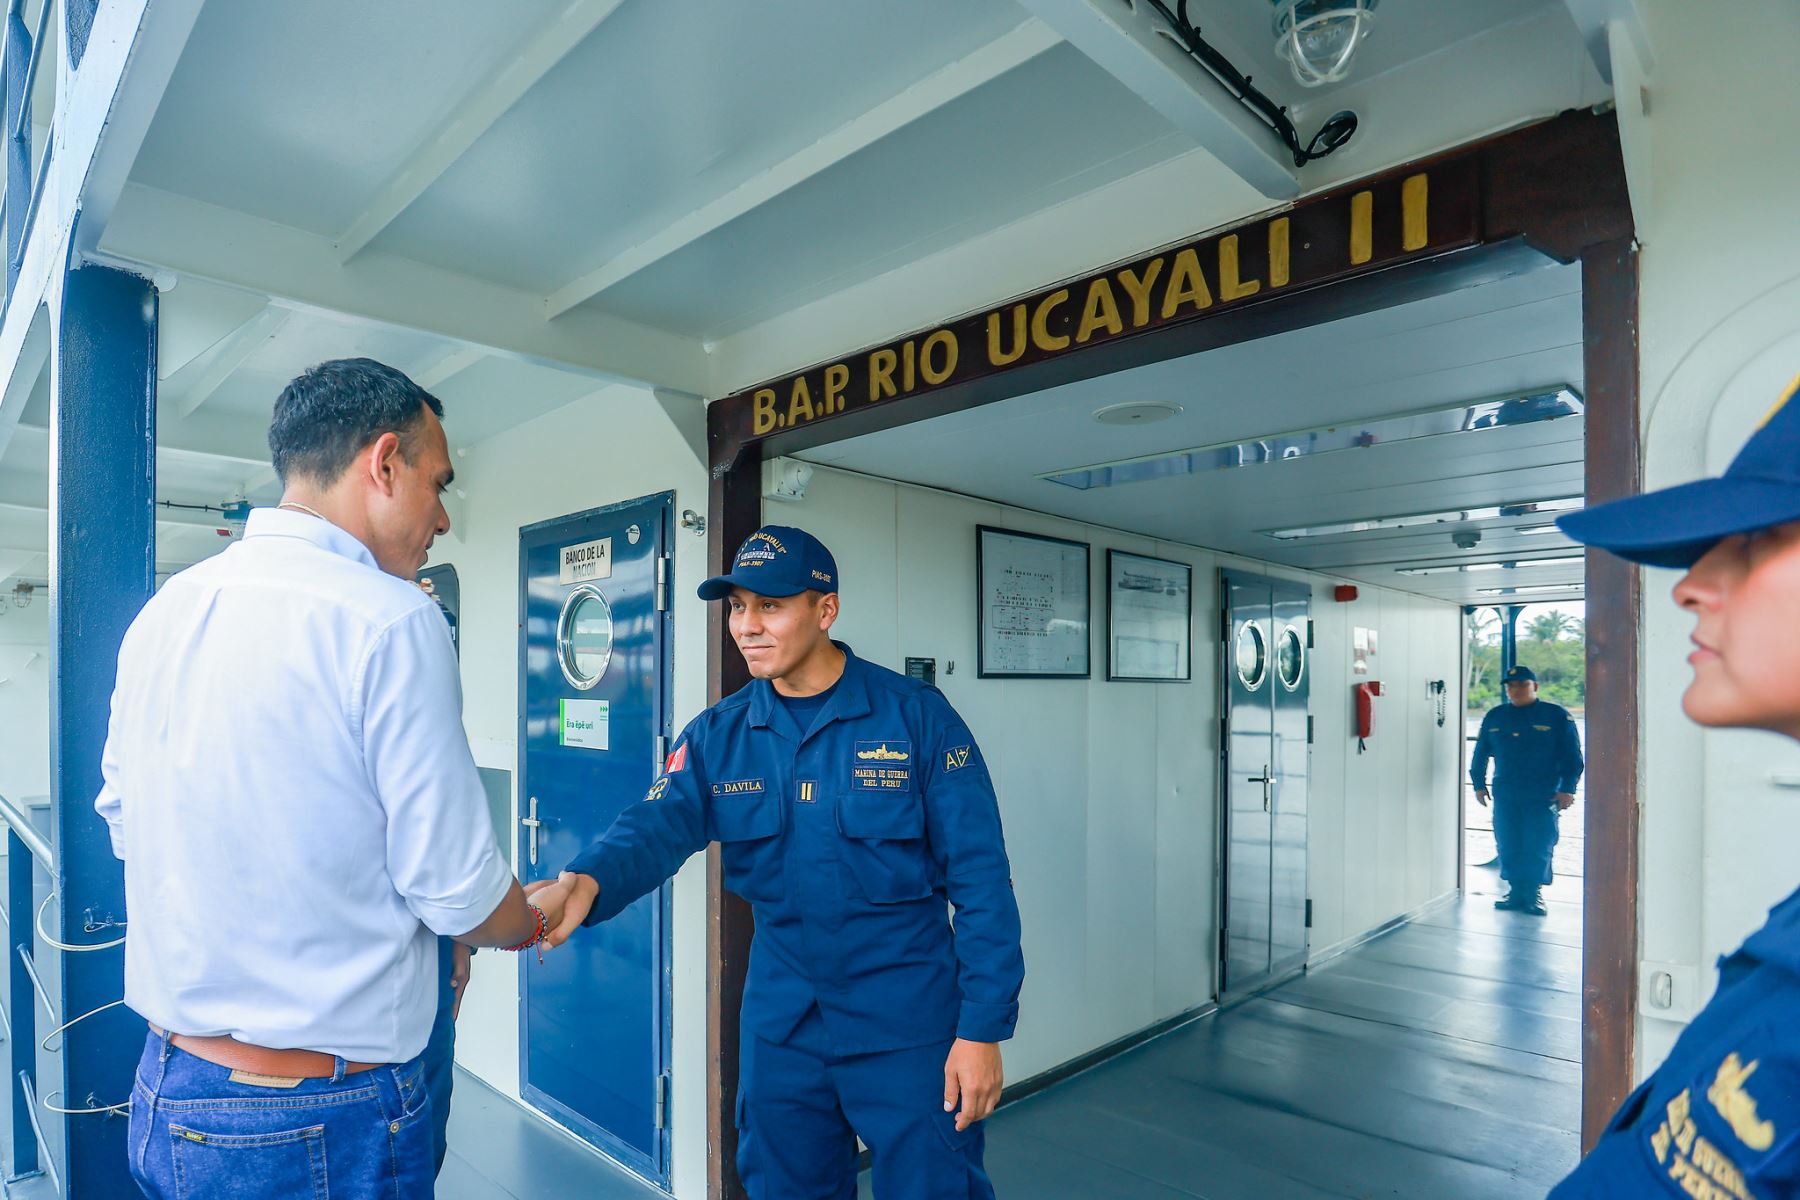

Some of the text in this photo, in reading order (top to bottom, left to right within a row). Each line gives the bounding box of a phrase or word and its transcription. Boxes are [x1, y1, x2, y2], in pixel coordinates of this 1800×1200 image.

[754, 174, 1428, 435] B.A.P. RIO UCAYALI II
[565, 544, 605, 565] BANCO DE LA
[854, 769, 909, 779] MARINA DE GUERRA
[724, 781, 762, 793] DAVILA
[863, 779, 902, 788] DEL PERU
